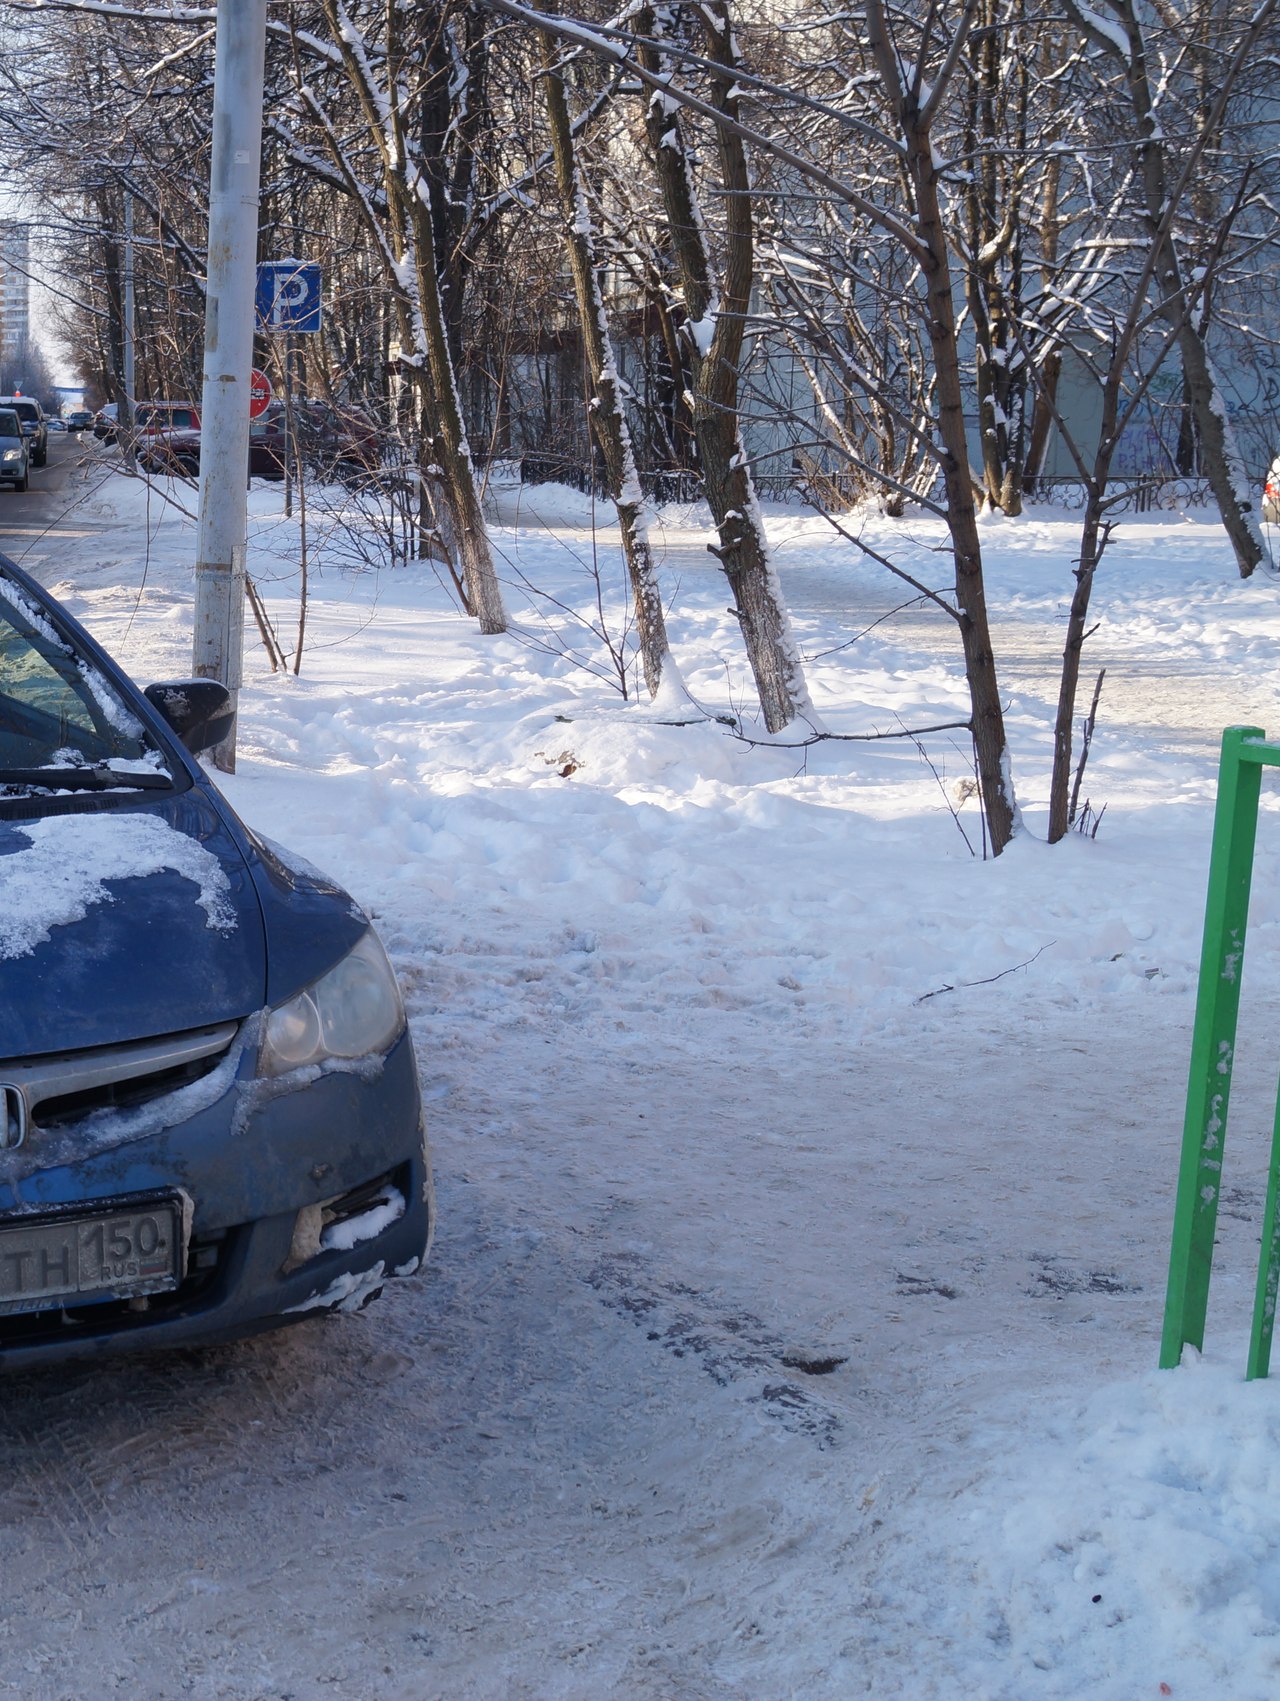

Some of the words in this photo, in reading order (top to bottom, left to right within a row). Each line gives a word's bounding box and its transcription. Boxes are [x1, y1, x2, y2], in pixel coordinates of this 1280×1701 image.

[273, 273, 309, 325] P
[80, 1217, 160, 1267] 150
[100, 1262, 138, 1281] RUS
